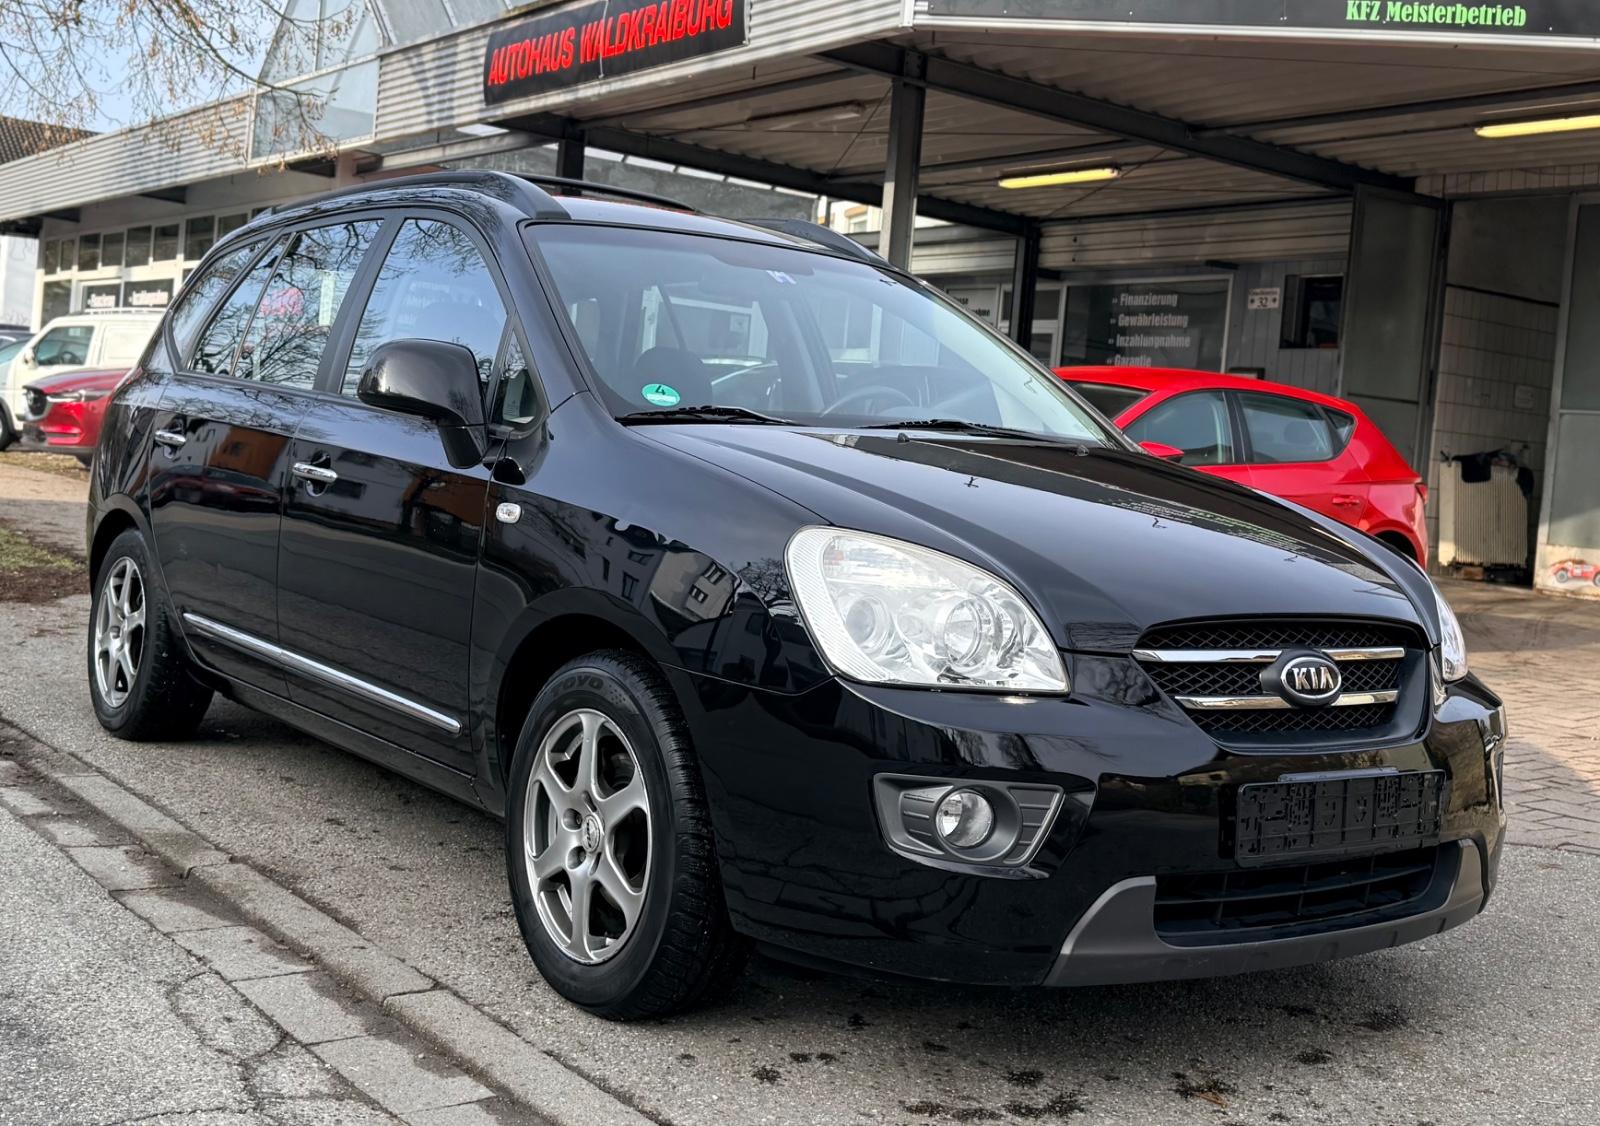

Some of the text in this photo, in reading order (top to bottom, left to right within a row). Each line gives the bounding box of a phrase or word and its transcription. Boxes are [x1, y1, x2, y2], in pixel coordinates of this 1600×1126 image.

[1346, 0, 1526, 27] KFZ Meisterbetrieb
[488, 0, 732, 86] AUTOHAUS WALDKRAIBURG
[1120, 293, 1178, 308] Finanzierung
[655, 385, 666, 396] 4
[1292, 666, 1335, 690] KIA
